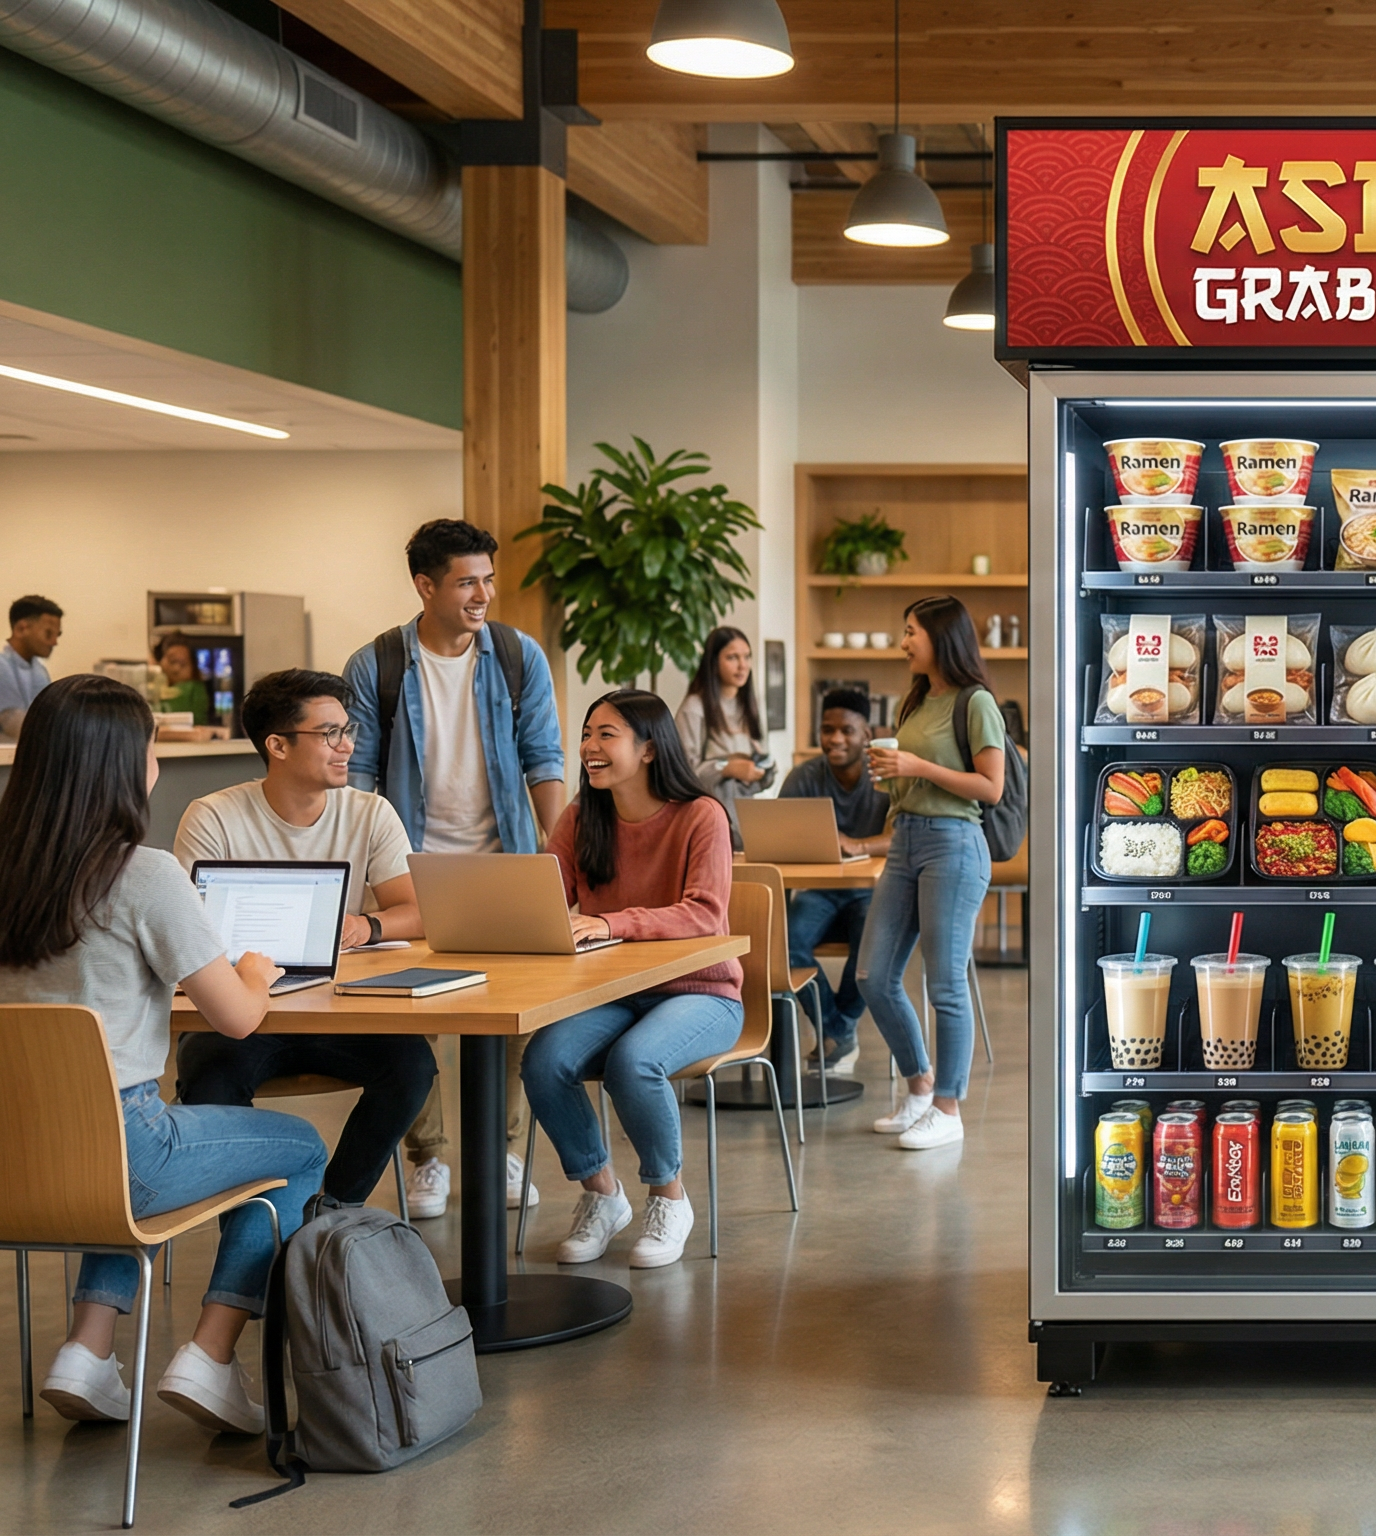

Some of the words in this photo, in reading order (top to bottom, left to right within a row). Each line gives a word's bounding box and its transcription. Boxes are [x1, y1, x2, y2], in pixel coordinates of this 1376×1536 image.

[1193, 265, 1376, 323] GRAB
[1120, 455, 1181, 469] Ramen
[1237, 455, 1297, 469] Ramen
[1120, 521, 1180, 535] Ramen
[1237, 521, 1296, 535] Ramen
